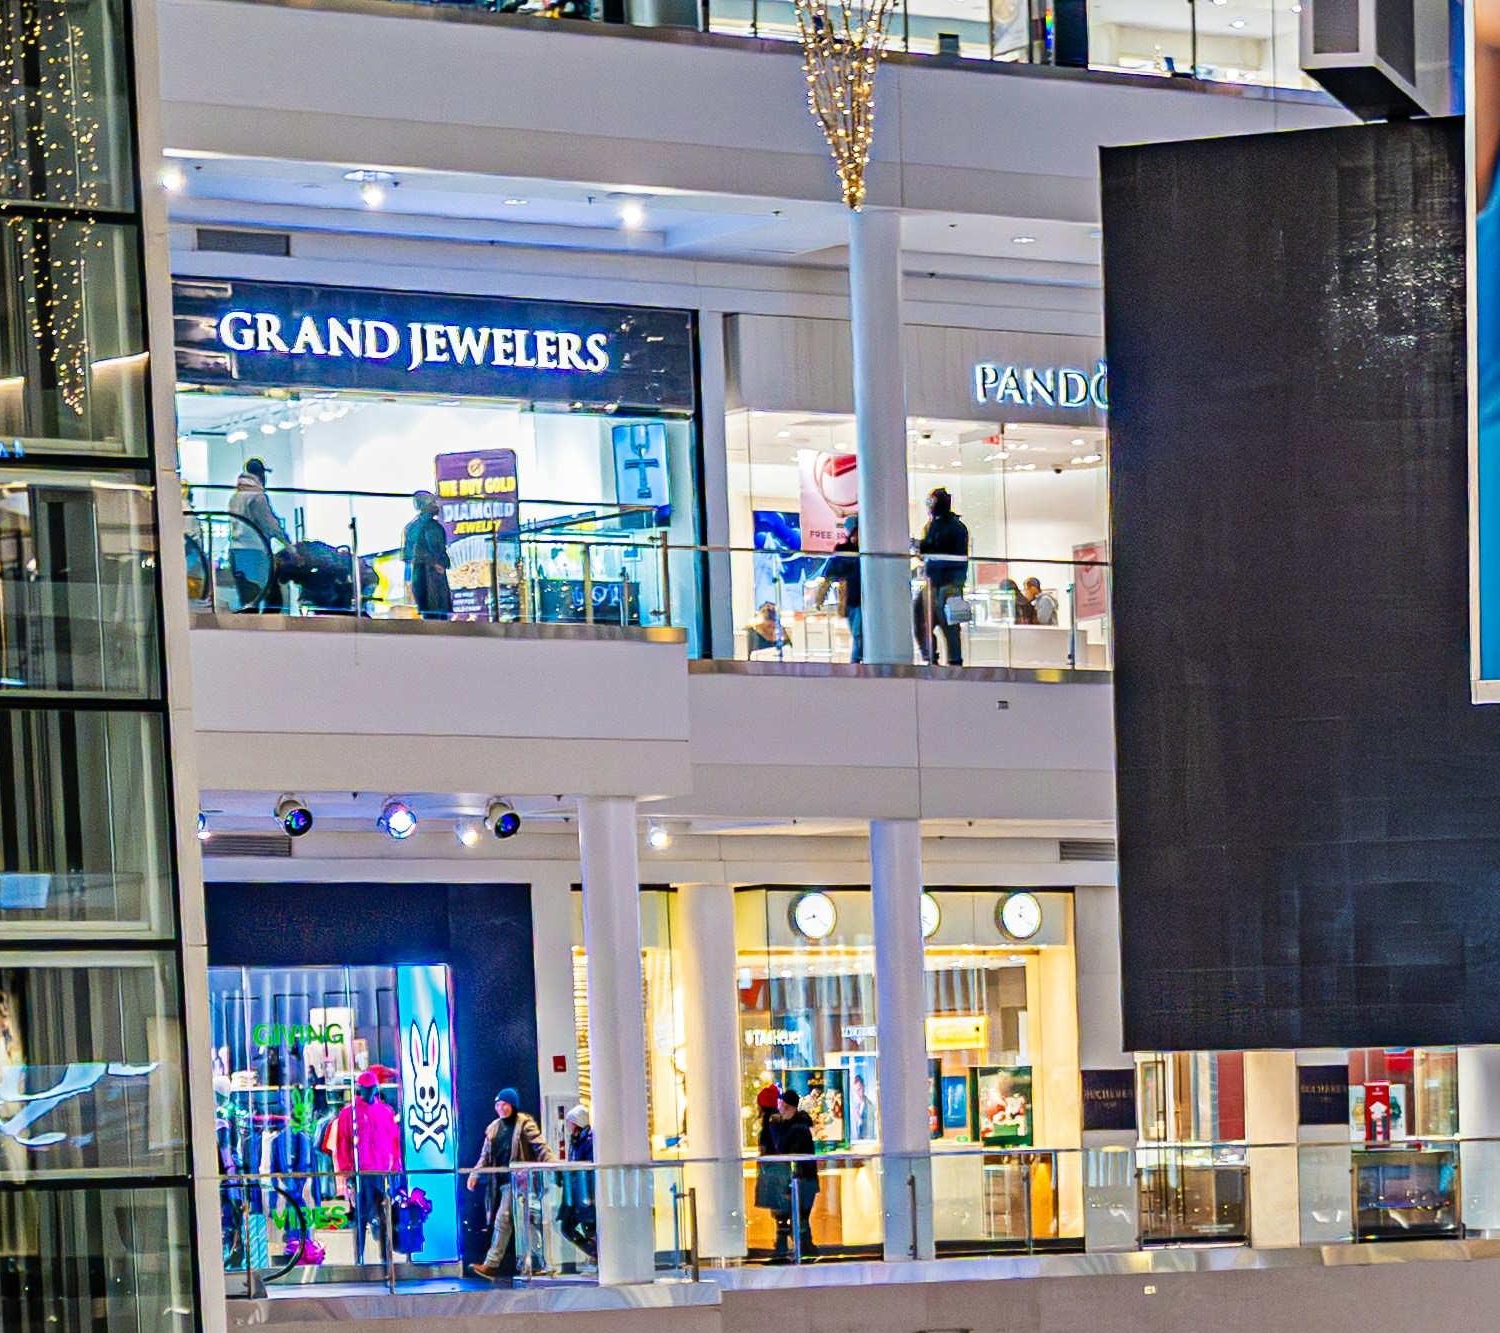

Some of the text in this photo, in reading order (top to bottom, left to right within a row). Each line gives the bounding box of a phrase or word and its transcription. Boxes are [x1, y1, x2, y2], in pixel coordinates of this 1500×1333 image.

[218, 311, 609, 374] GRAND JEWELERS
[459, 478, 483, 496] BUY
[484, 476, 516, 494] GOLD
[254, 1022, 344, 1047] GIVING
[273, 1205, 348, 1231] VIBES
